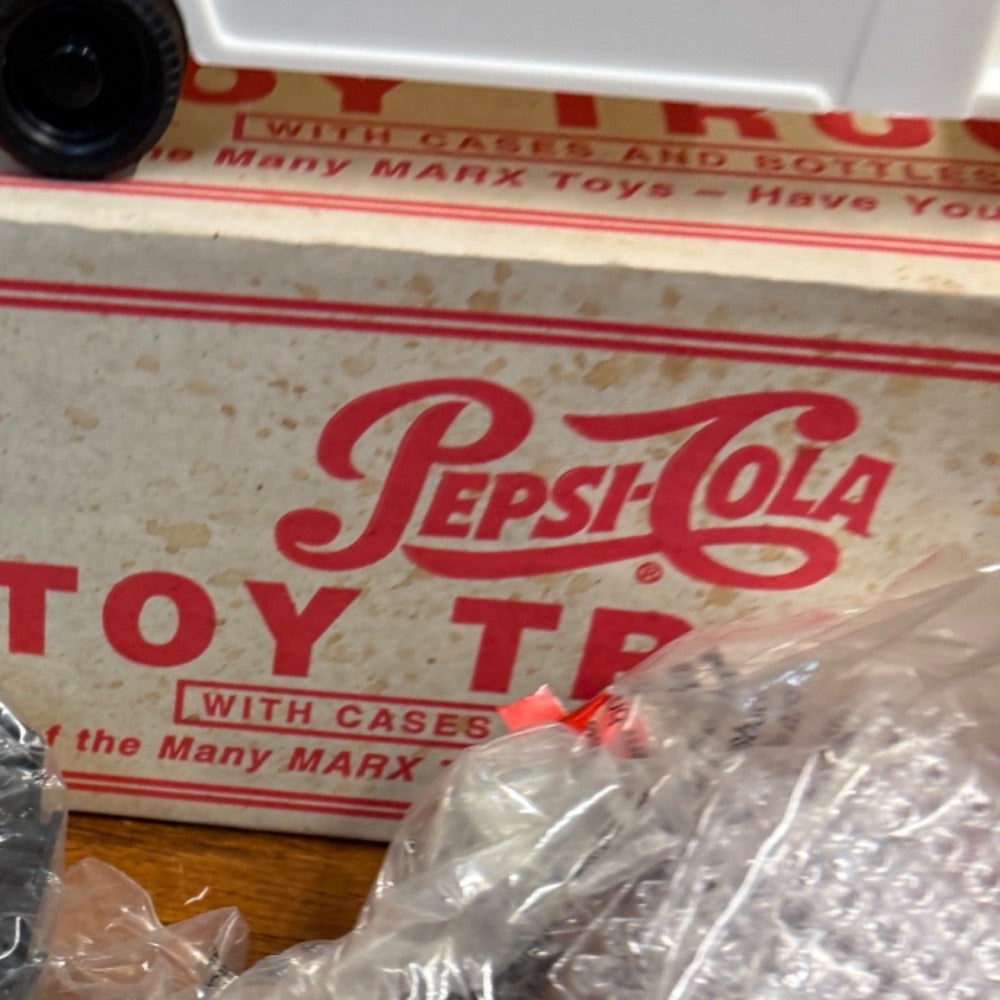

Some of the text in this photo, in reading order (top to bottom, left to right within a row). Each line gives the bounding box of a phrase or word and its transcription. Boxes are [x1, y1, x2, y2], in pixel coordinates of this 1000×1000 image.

[213, 147, 351, 177] Many
[370, 158, 527, 188] MARX
[549, 170, 675, 200] Toys
[747, 184, 880, 212] Have
[266, 119, 1000, 186] WITH CASES AND BOTTLES
[451, 596, 696, 701] TR
[202, 692, 491, 740] WITH CASES
[75, 728, 142, 757] the
[157, 735, 274, 774] Many
[286, 746, 424, 782] MARX
